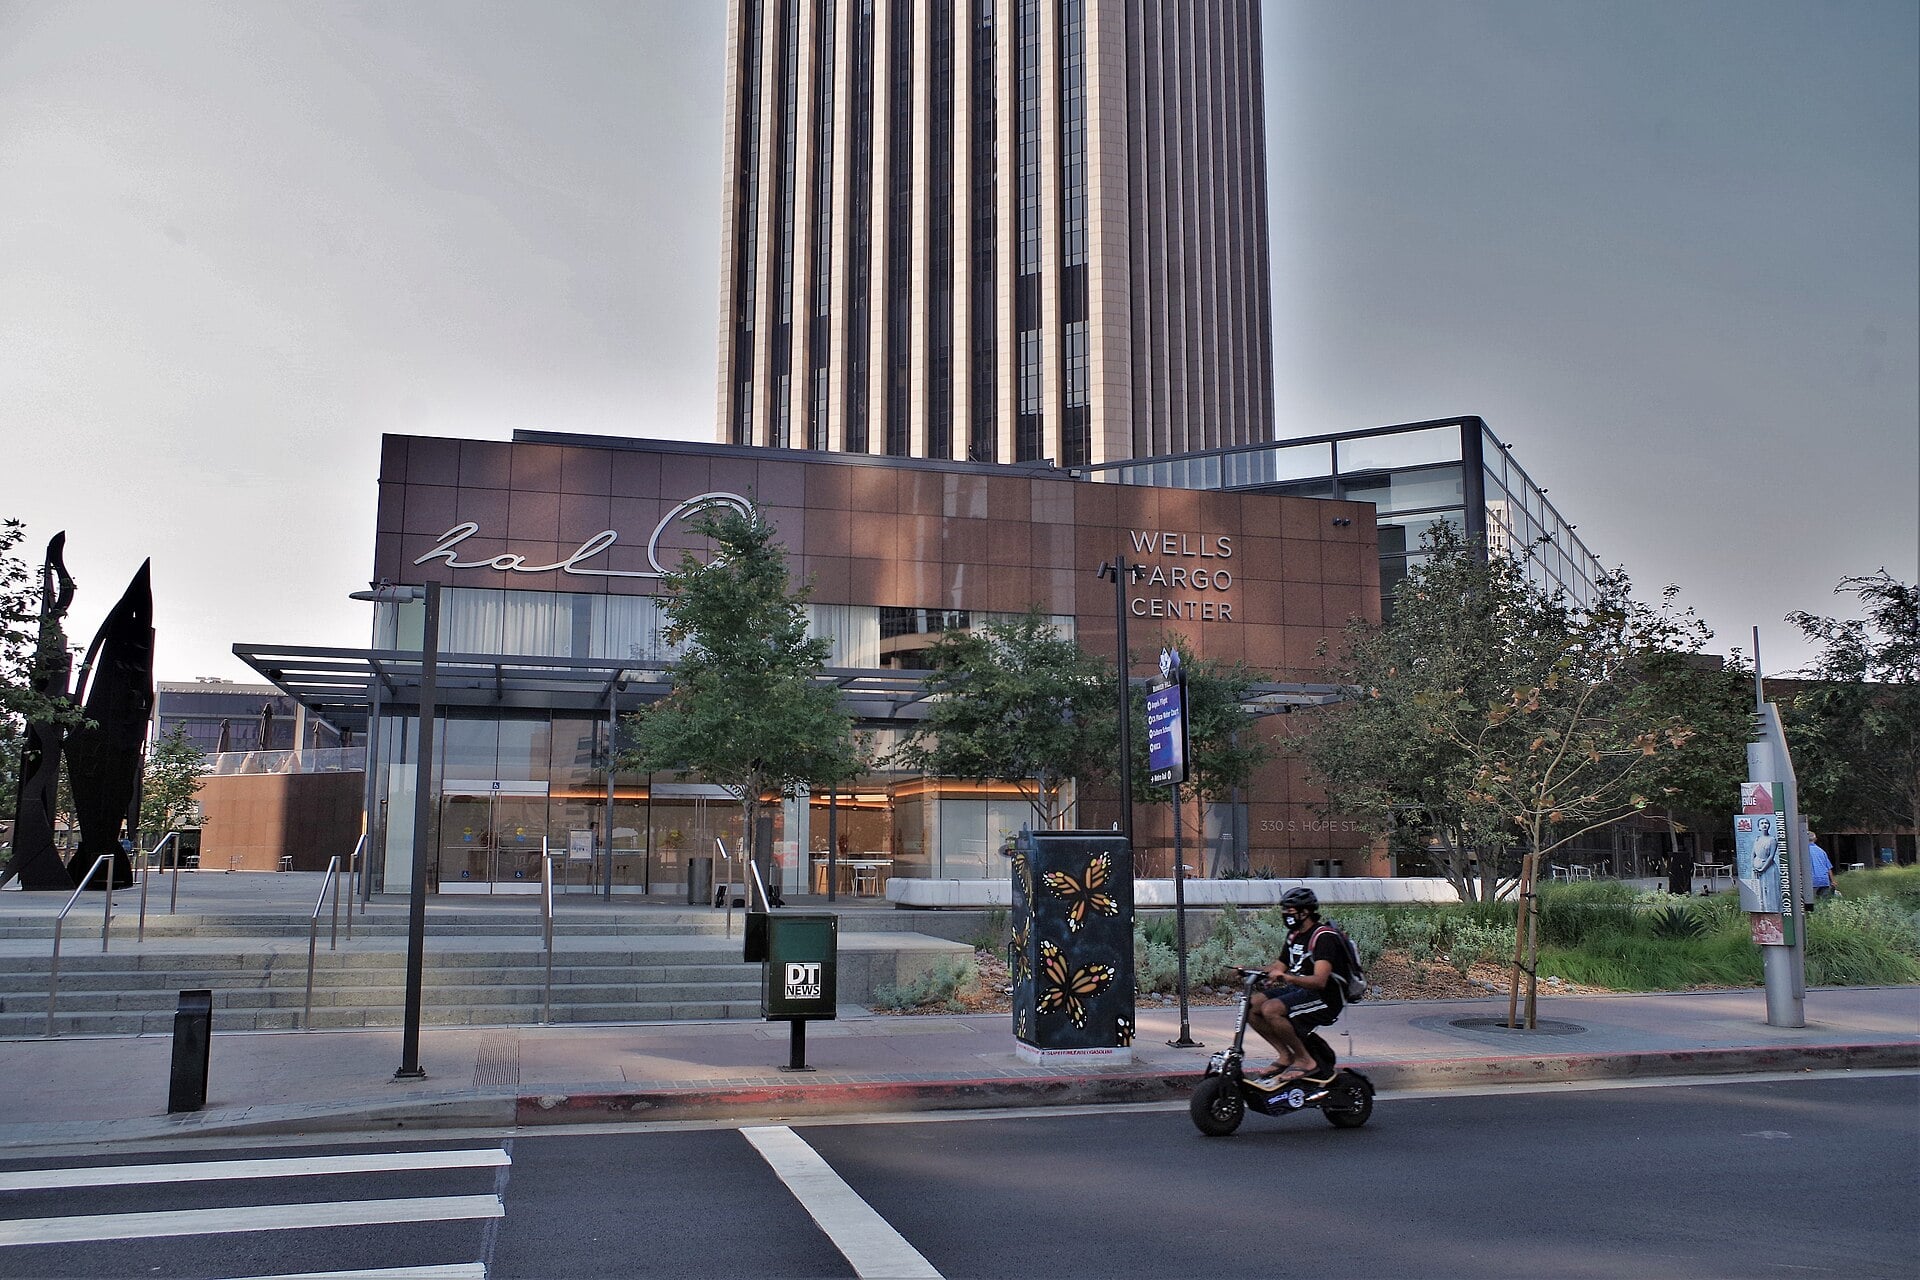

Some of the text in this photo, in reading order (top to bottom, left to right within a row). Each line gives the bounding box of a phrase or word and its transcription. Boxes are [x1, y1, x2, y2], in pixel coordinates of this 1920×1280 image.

[1130, 530, 1233, 558] WELLS
[1131, 564, 1233, 591] FARGO
[1131, 598, 1233, 621] CENTER
[1260, 820, 1284, 832] 330
[1302, 820, 1337, 832] HOPE
[1775, 811, 1785, 840] BUNKER
[1777, 841, 1787, 855] HILL
[1779, 863, 1790, 896] HISTORIC
[1782, 898, 1792, 917] CORE
[787, 964, 819, 985] DT
[786, 985, 820, 995] NEWS
